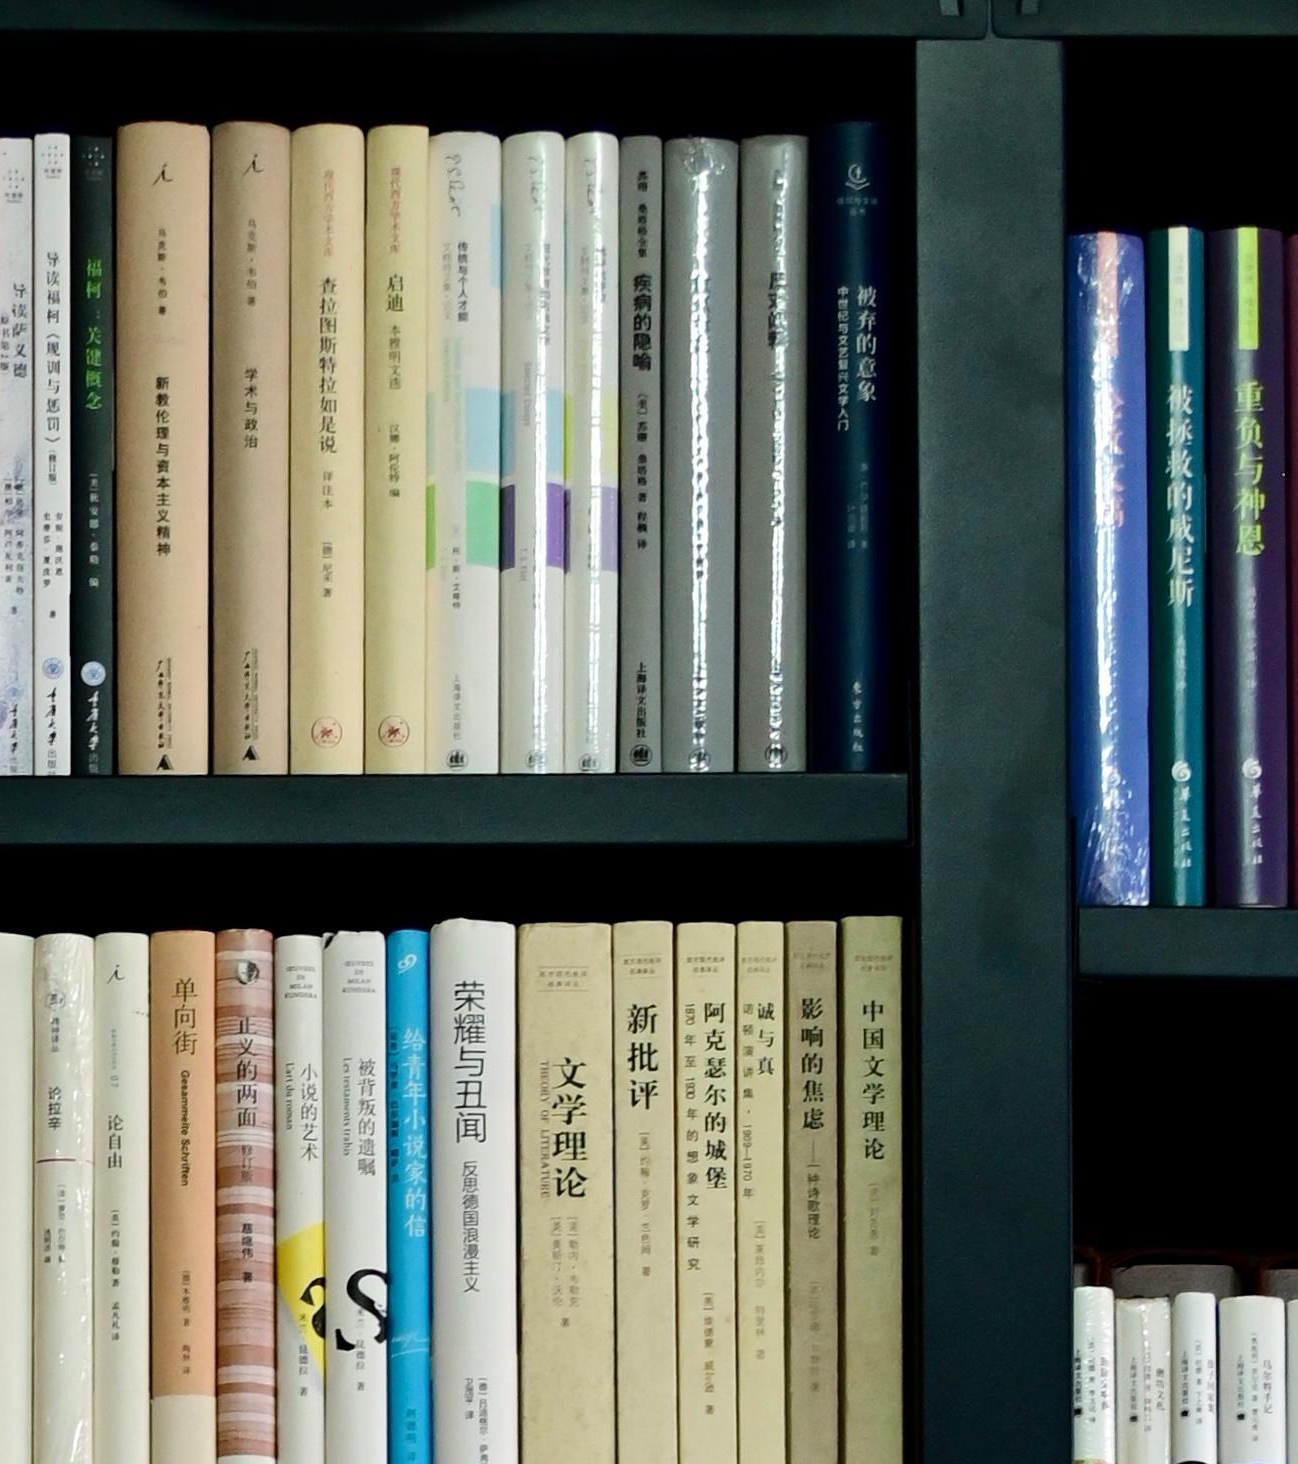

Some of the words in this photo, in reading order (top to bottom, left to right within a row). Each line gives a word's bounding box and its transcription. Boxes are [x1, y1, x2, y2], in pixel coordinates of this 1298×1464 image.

[244, 367, 259, 449] 学术与政治
[319, 276, 338, 454] 查拉图斯特拉如是说
[837, 285, 850, 432] 中世纪与文艺复兴文学入门
[856, 284, 877, 403] 被弃的意象
[155, 376, 171, 557] 新教伦理与资本主义精神
[1166, 382, 1194, 608] 被拯救的威尼斯
[1232, 380, 1266, 556] 重负与神恩
[174, 977, 198, 1056] 单向街
[454, 980, 487, 1144] 荣耀与丑闻
[628, 1003, 659, 1110] 新批评
[862, 999, 885, 1161] 中国文学理论
[403, 1025, 429, 1238] 给青年小说家的信
[553, 1056, 587, 1198] 文学理论
